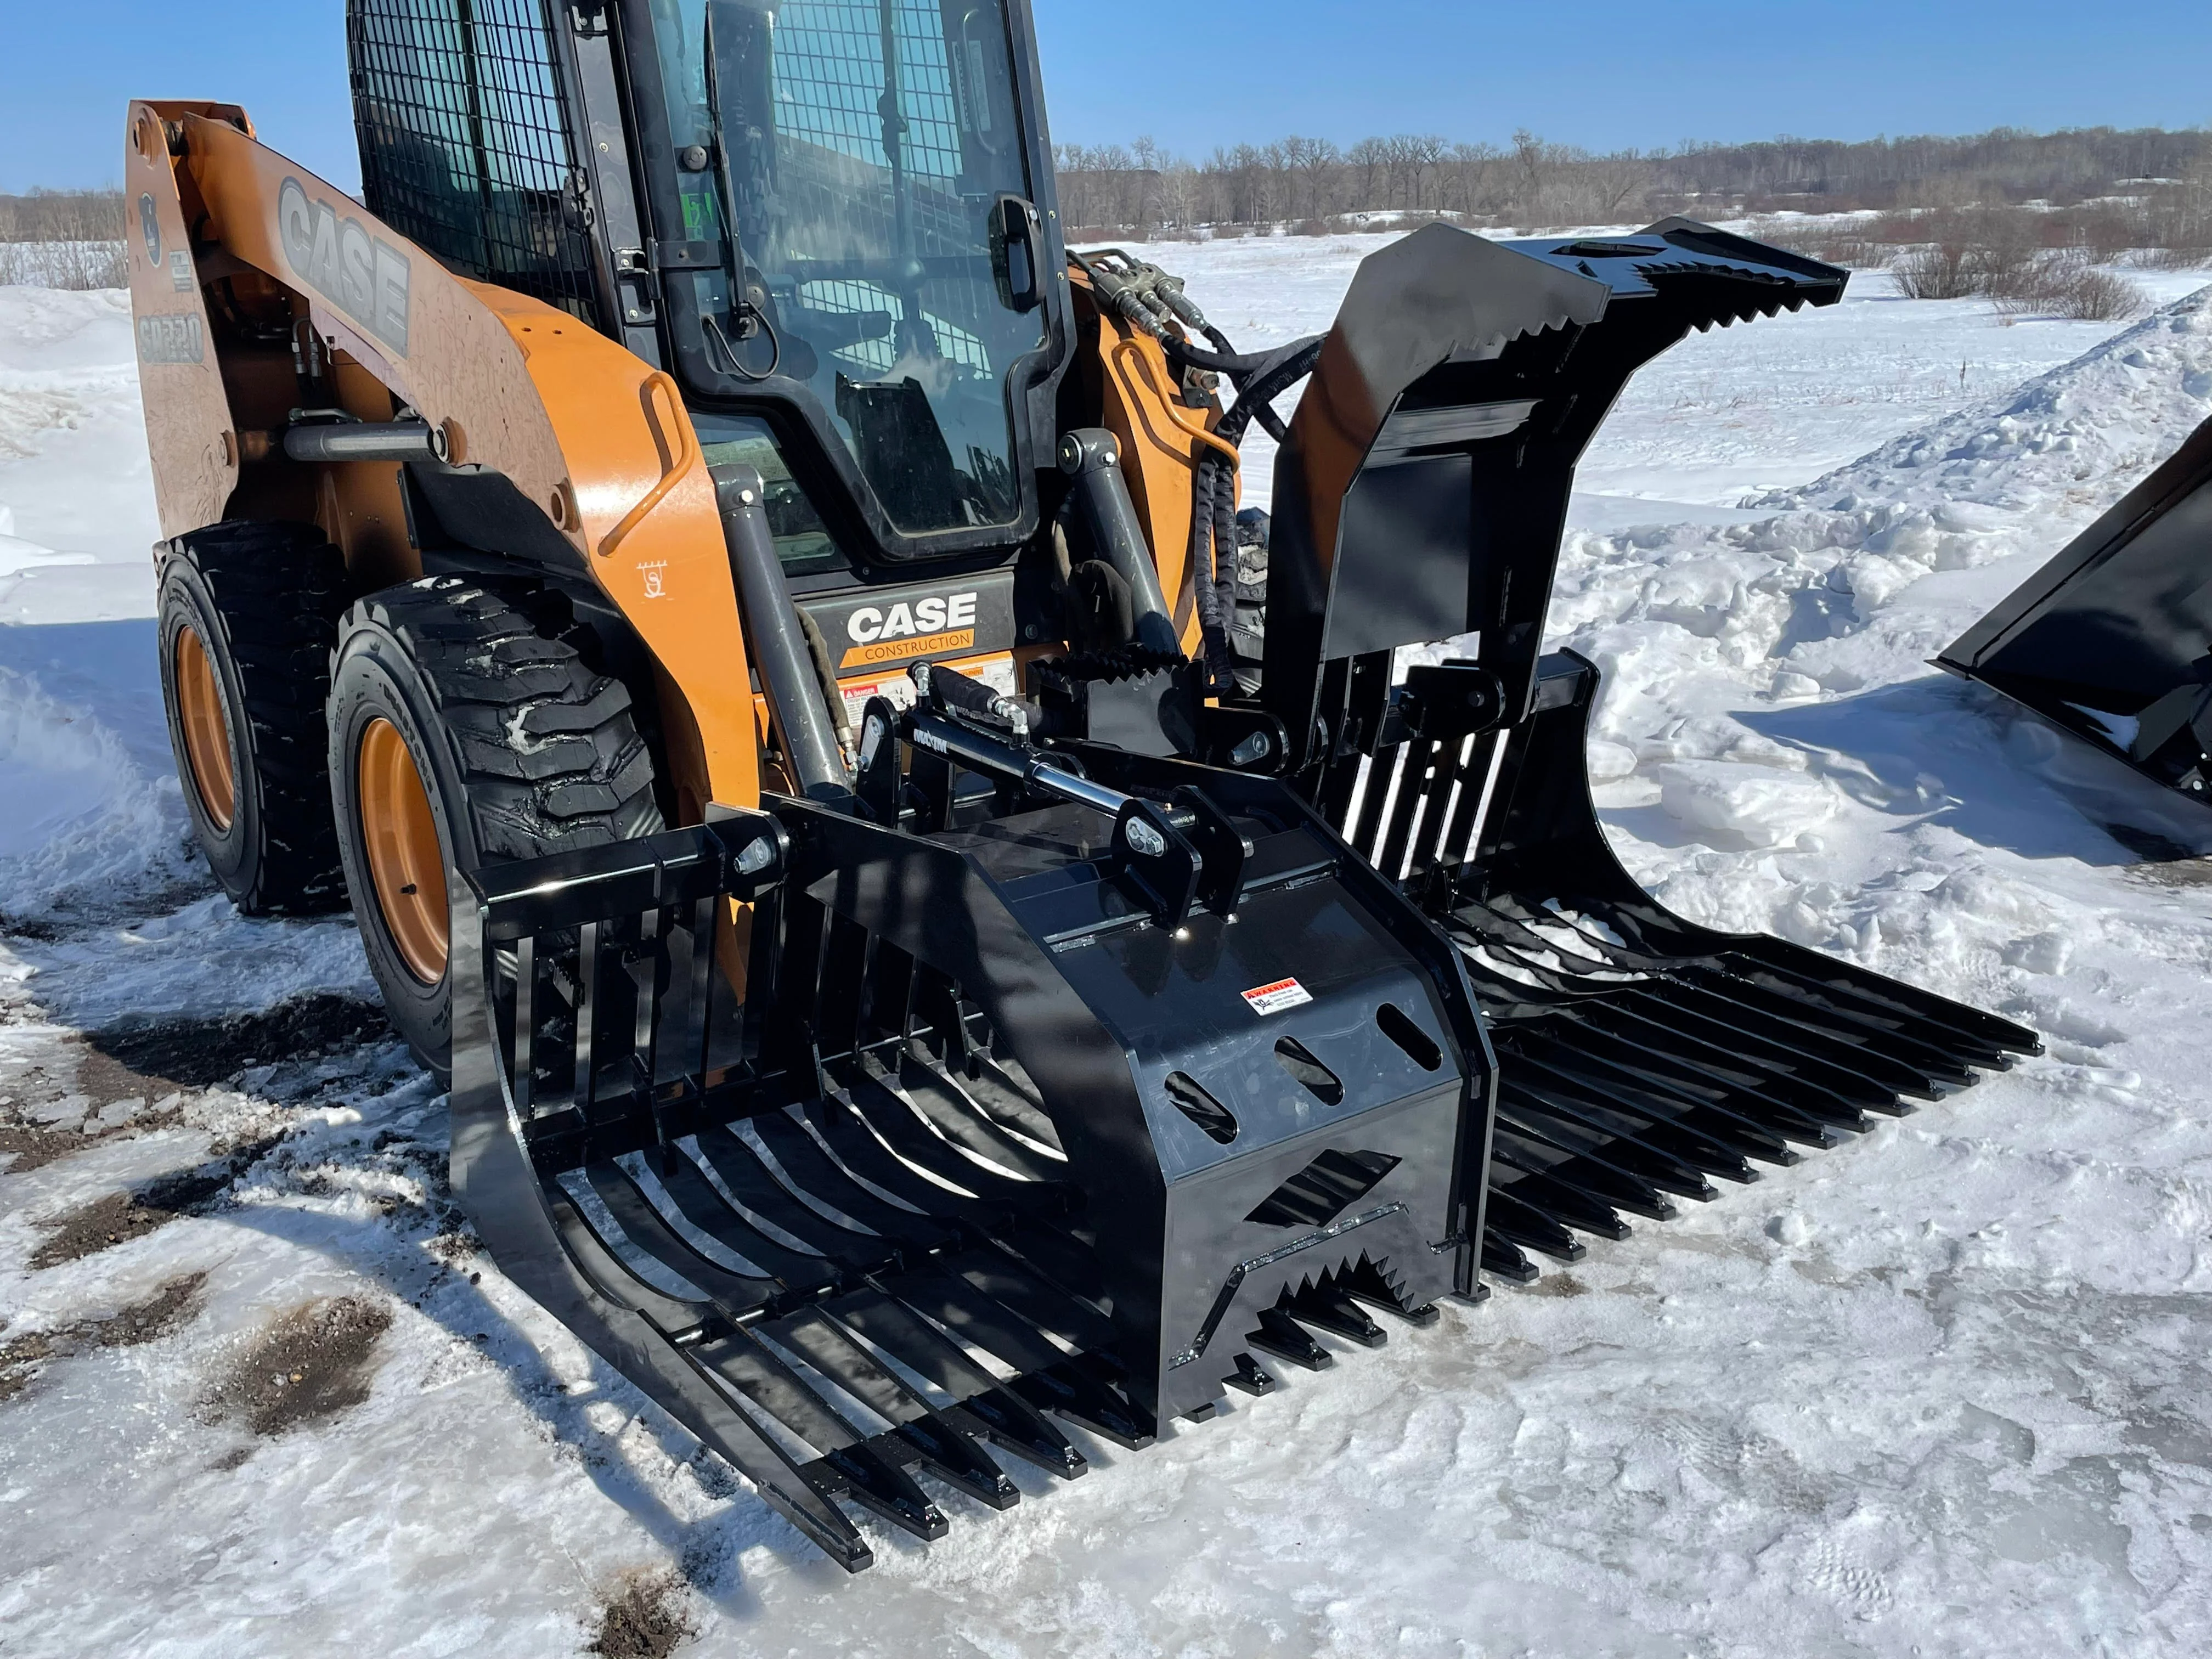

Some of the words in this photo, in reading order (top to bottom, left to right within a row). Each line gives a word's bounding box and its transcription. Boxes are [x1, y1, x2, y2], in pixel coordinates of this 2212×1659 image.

[279, 178, 409, 356] CASE
[848, 592, 977, 642] CASE
[865, 633, 970, 660] CONSTRUCTION
[853, 688, 876, 697] DANGER
[913, 729, 947, 754] MAXIM
[1254, 981, 1296, 996] WARNING
